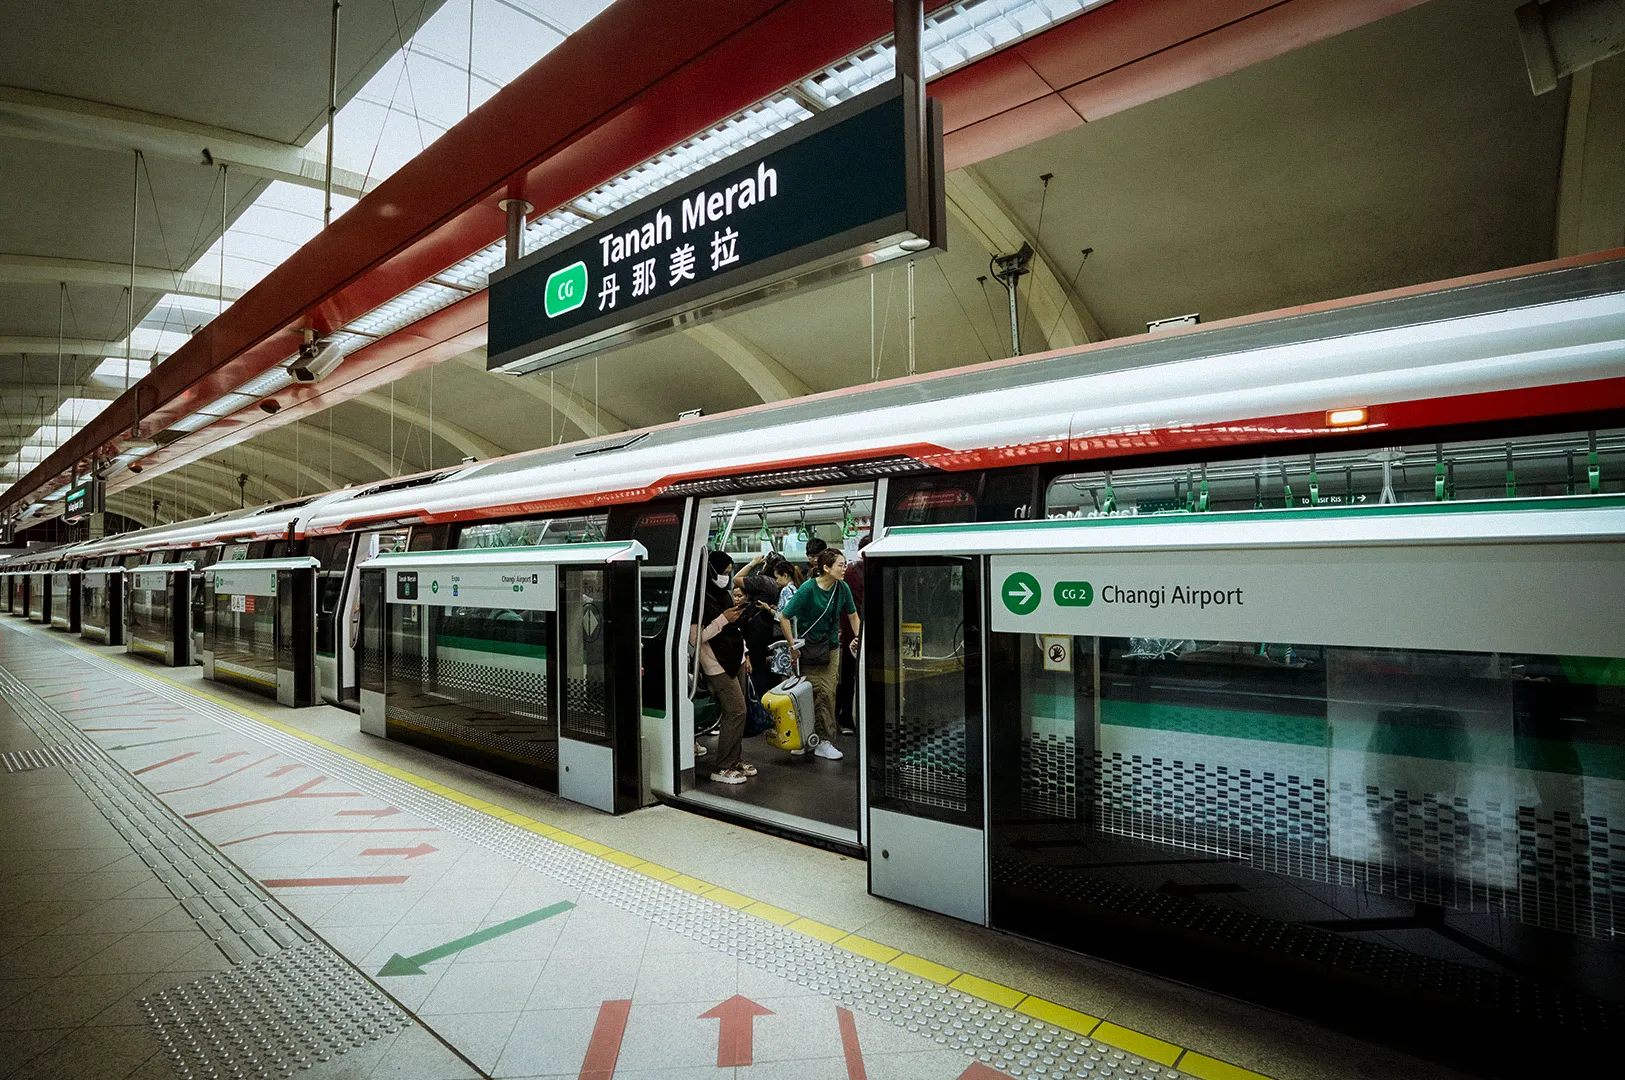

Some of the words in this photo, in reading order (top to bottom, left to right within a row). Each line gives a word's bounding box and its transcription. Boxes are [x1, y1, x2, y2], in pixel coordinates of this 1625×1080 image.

[599, 208, 672, 267] Tanah
[681, 161, 778, 233] Merah
[598, 226, 740, 312] 丹那美拉
[557, 278, 574, 301] CG
[501, 575, 515, 584] Changi
[516, 575, 531, 584] Airport
[1061, 588, 1077, 600] CG
[1079, 588, 1087, 600] 2
[1101, 585, 1166, 608] Changi
[1171, 586, 1244, 609] Airport
